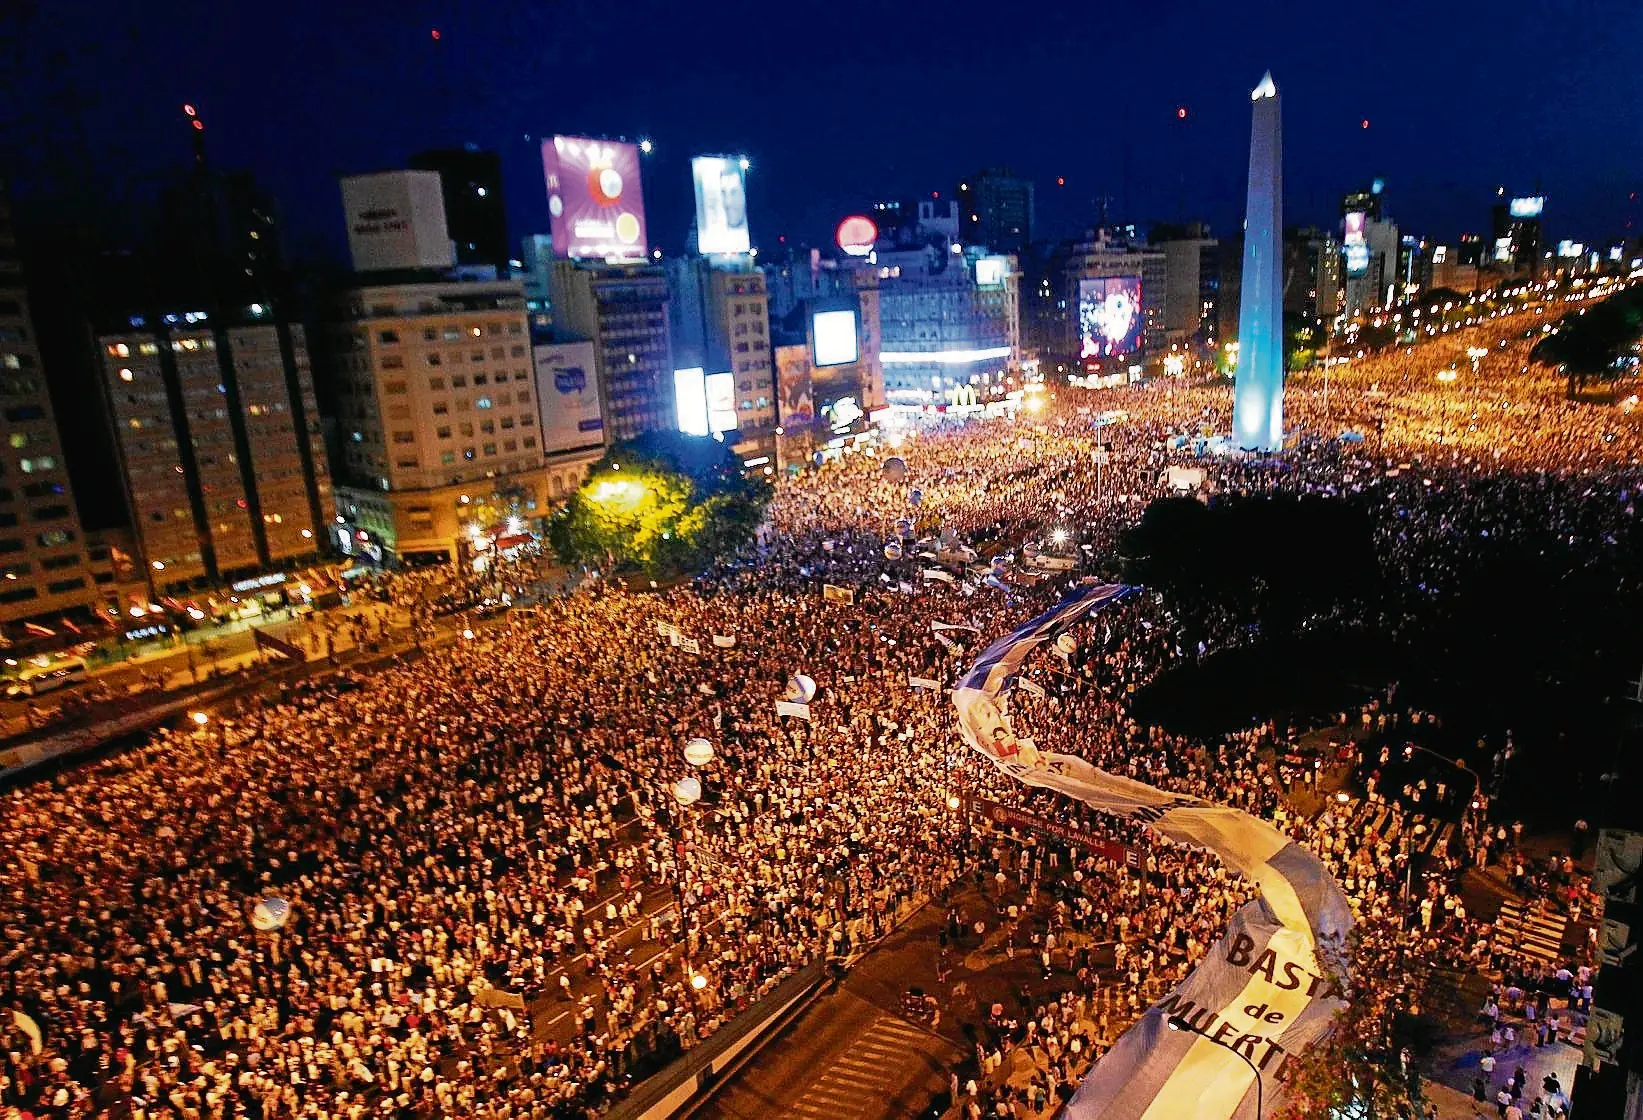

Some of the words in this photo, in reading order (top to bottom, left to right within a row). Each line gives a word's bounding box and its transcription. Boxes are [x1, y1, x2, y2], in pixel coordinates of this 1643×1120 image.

[1046, 823, 1064, 836] POR
[1067, 831, 1105, 849] LAVALLE
[1243, 1003, 1285, 1024] de
